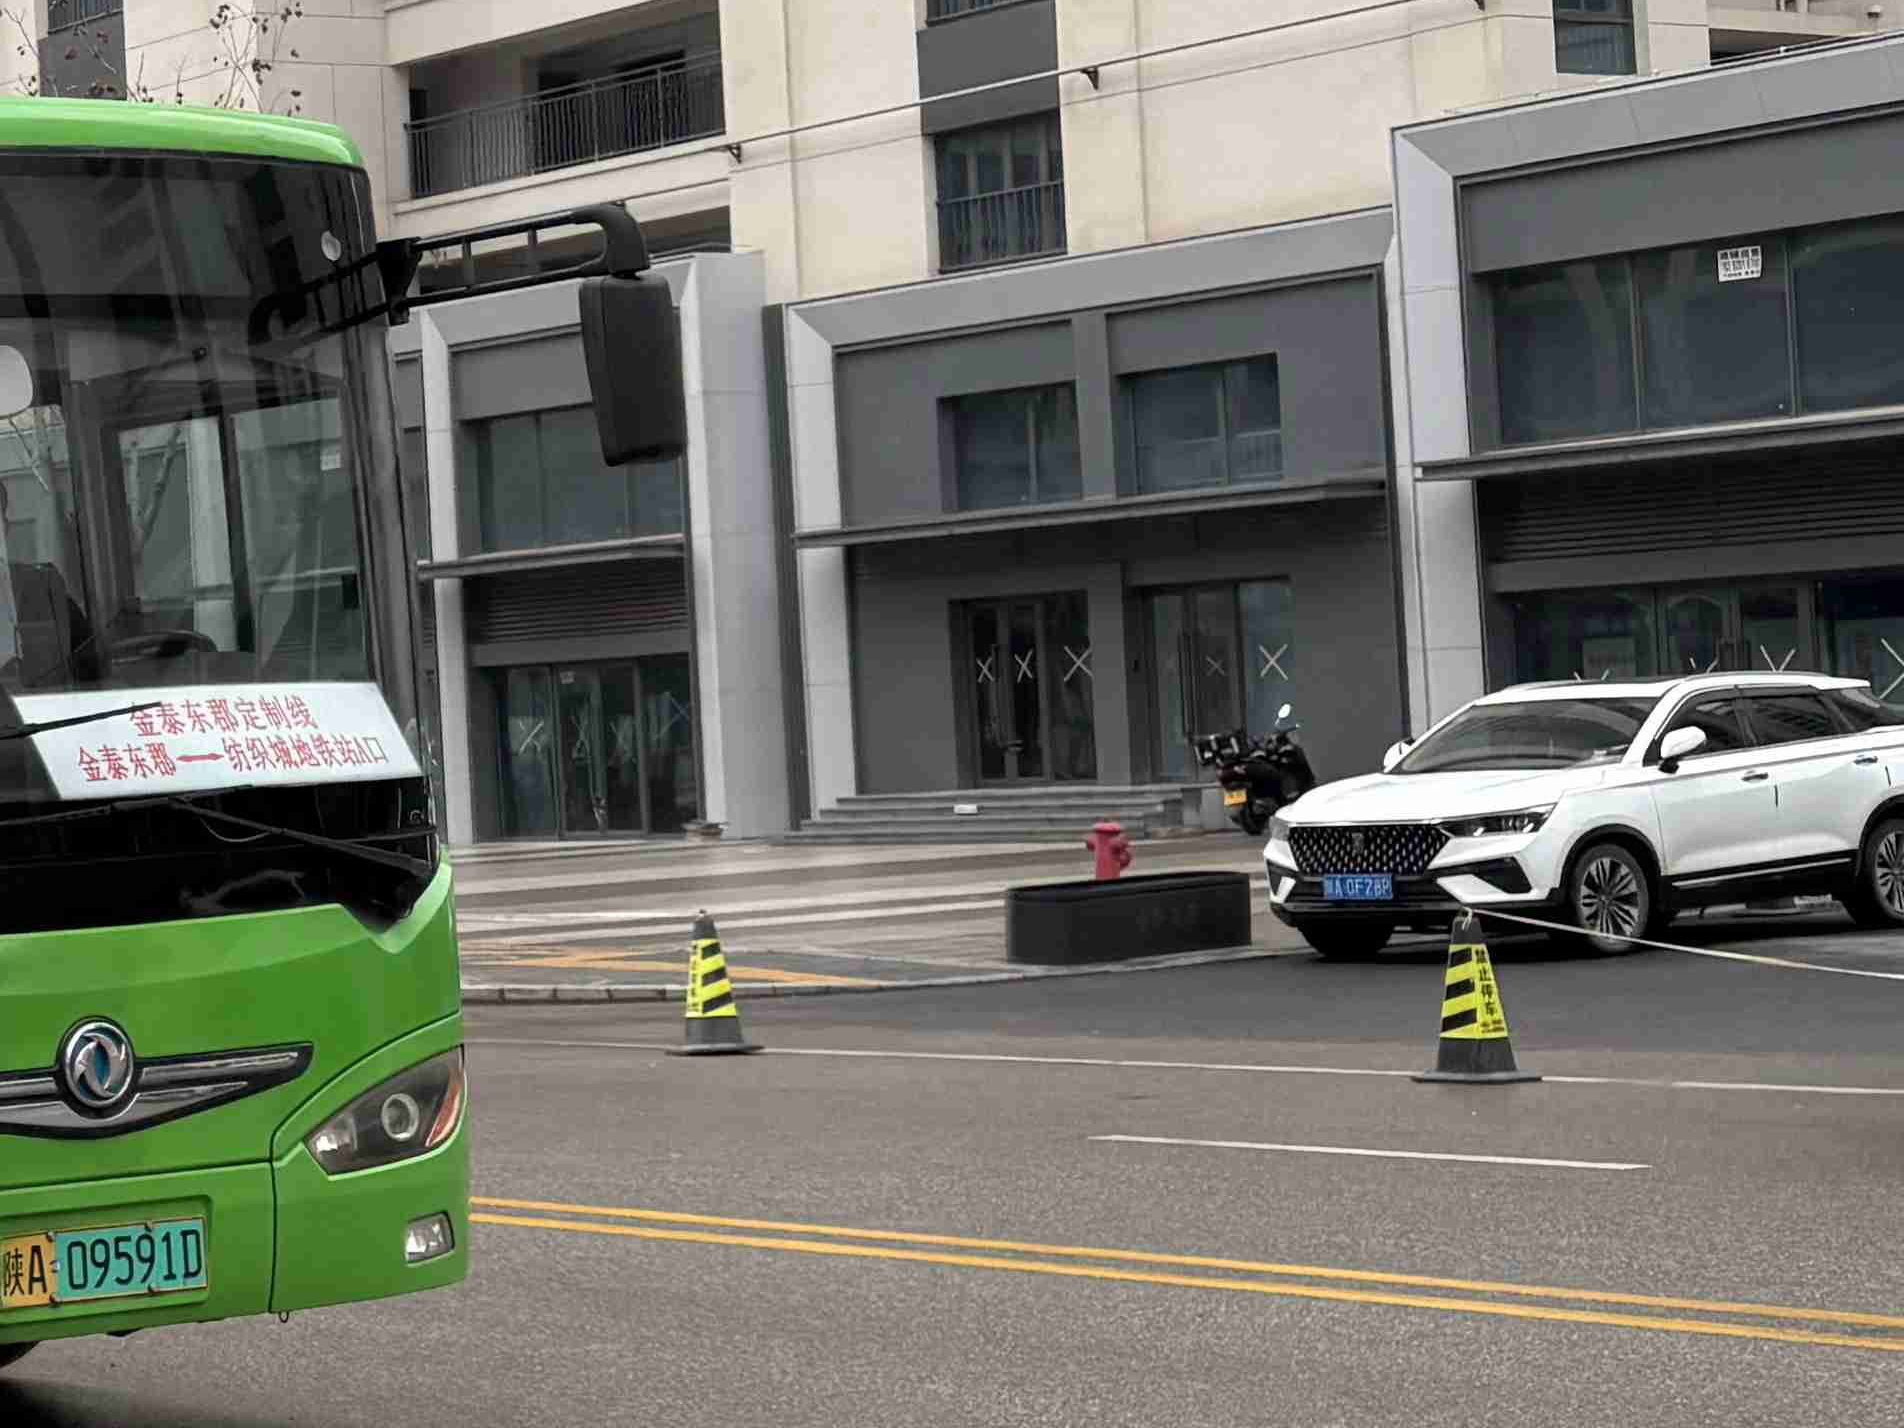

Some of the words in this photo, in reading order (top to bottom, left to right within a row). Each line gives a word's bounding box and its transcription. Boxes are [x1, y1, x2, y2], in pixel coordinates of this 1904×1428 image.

[130, 694, 320, 737] 金泰东郡定制线
[78, 742, 177, 783] 金泰东郡
[222, 735, 389, 772] 纺织城地铁站A口
